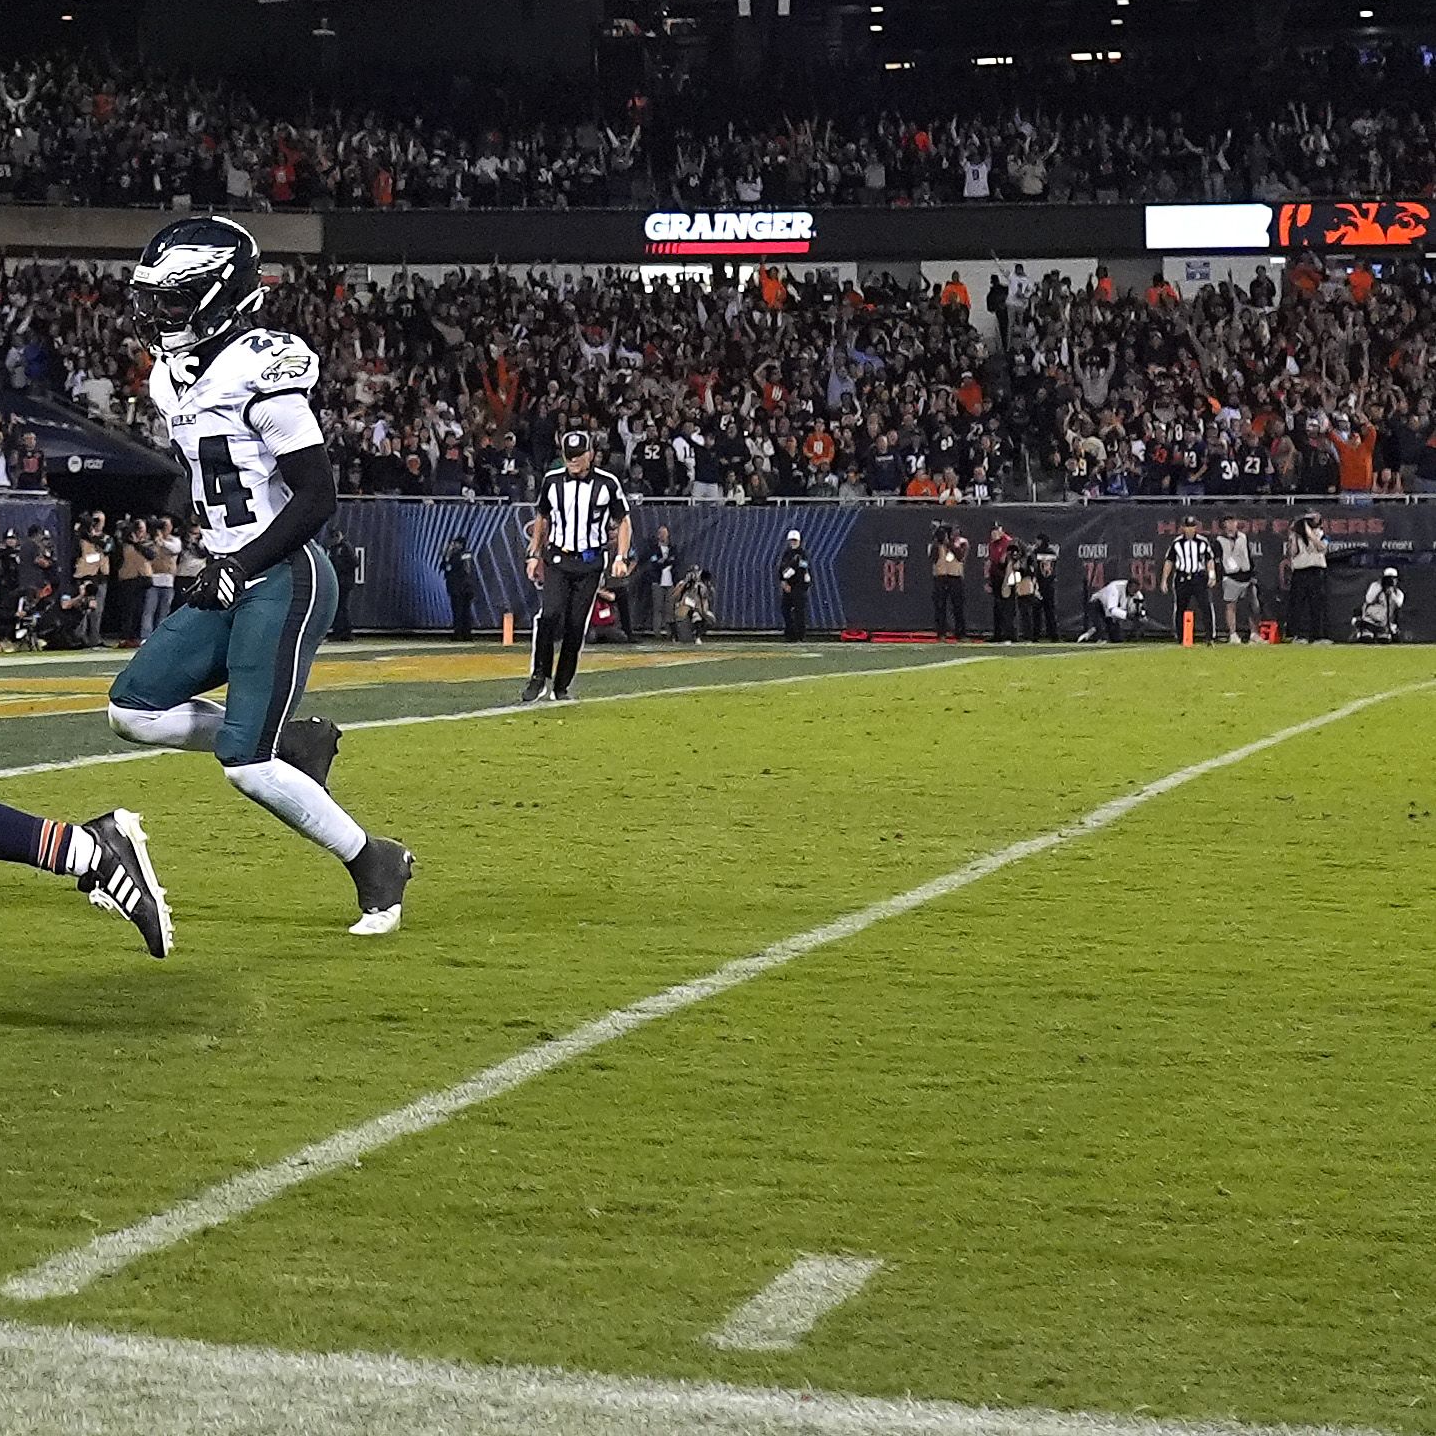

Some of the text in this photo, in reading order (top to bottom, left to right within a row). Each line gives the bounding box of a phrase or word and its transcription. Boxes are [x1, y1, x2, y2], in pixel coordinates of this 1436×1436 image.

[644, 212, 815, 241] GRAINGER
[644, 444, 660, 460] 52
[171, 434, 258, 530] 4
[879, 543, 909, 558] ATKINS
[1078, 543, 1108, 559] COVERT
[1132, 542, 1154, 557] DENT
